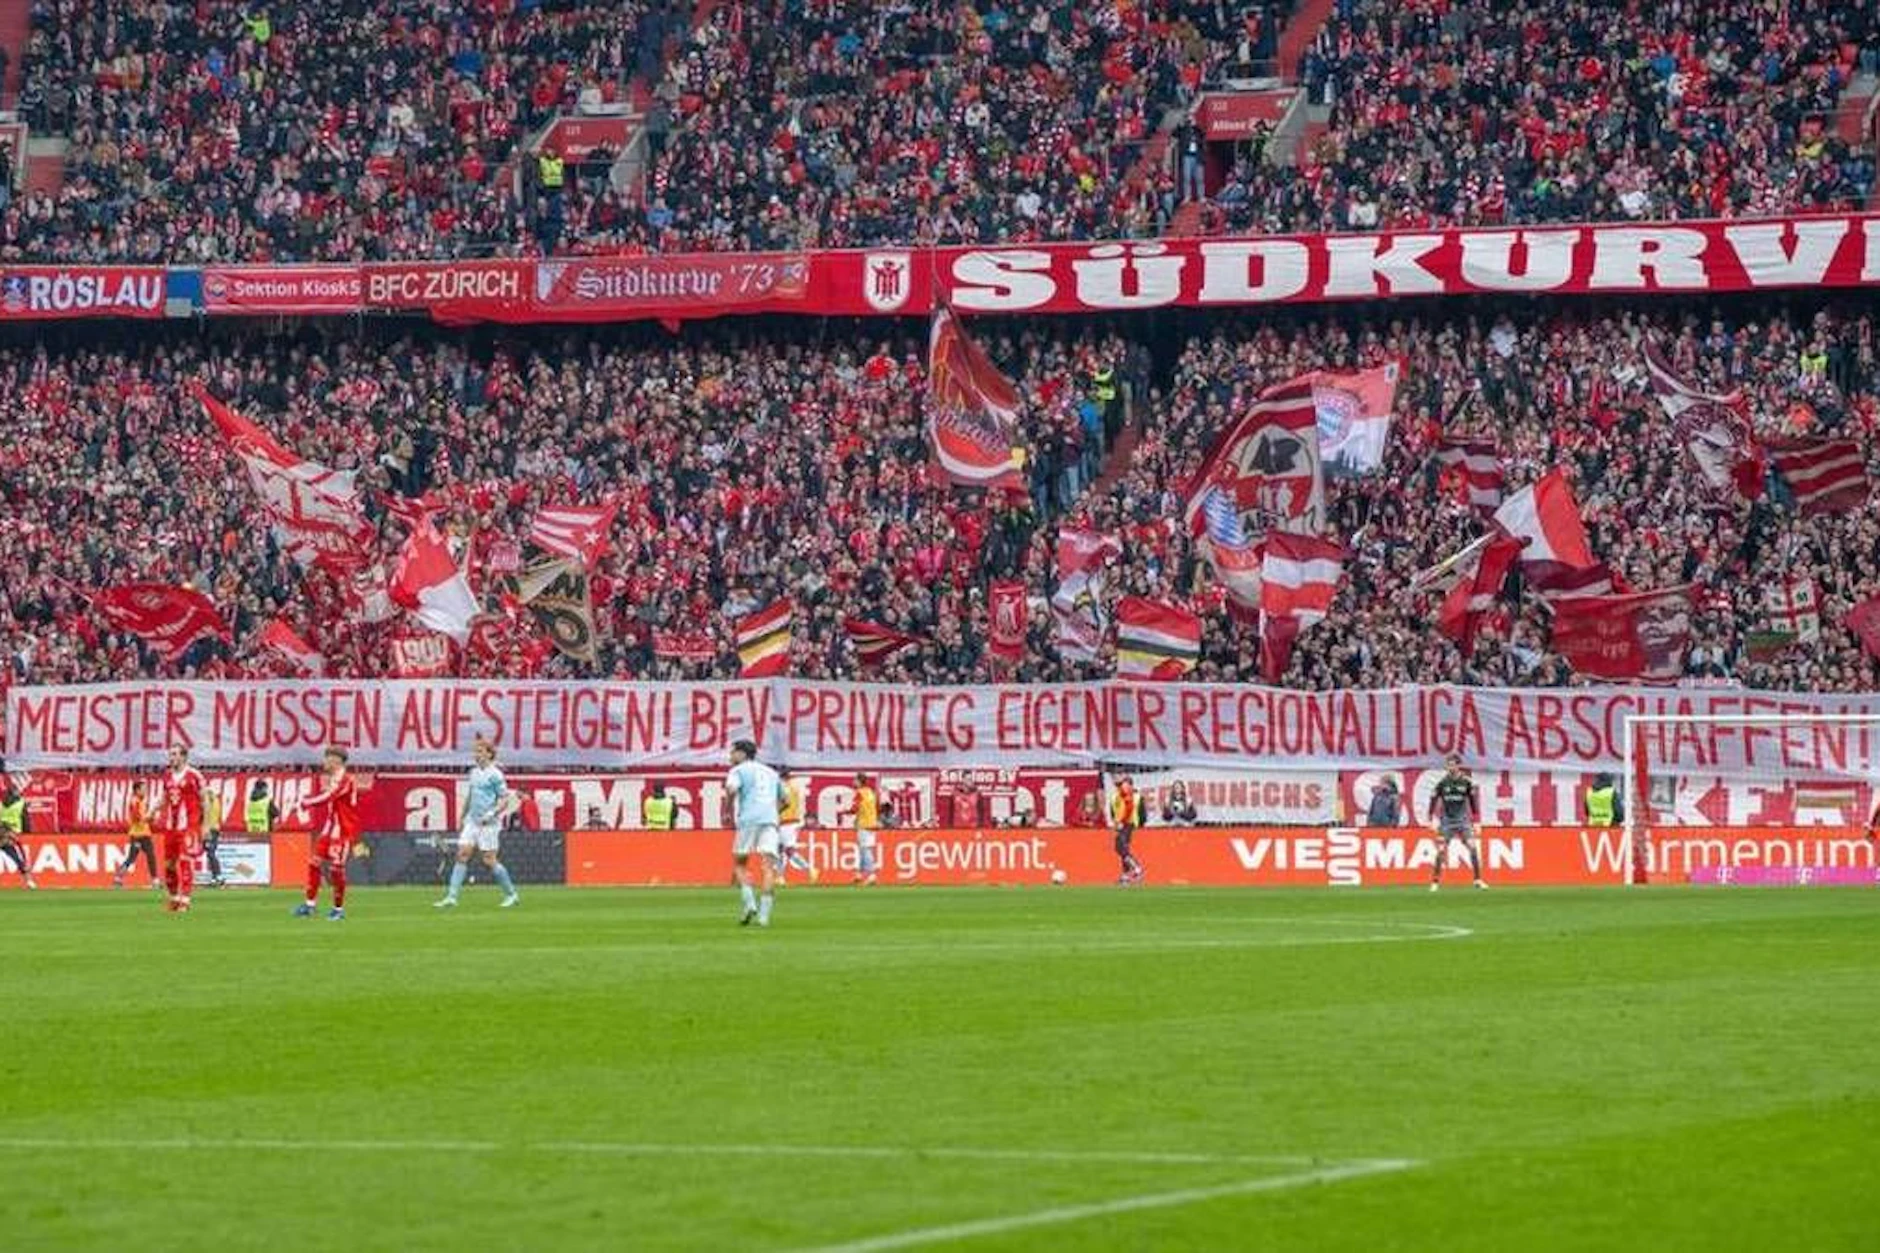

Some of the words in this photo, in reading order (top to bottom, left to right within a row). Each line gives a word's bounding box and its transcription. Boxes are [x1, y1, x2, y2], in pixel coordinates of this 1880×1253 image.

[29, 273, 161, 311] RÖSLAU
[234, 280, 298, 297] Sektion
[370, 268, 420, 302] BFC
[424, 265, 519, 299] ZÜRICH
[573, 267, 722, 299] Südkurve
[730, 263, 774, 293] '73
[14, 688, 196, 753] MEISTER
[212, 687, 382, 752] MÜSSEN
[397, 687, 672, 752] AUFSTEIGEN!
[995, 686, 1166, 752] EIGENER
[1178, 688, 1485, 758] REGIONALLIGA
[1503, 692, 1869, 772] ABSCHAFFEN!
[895, 831, 1056, 879] gewinnt.
